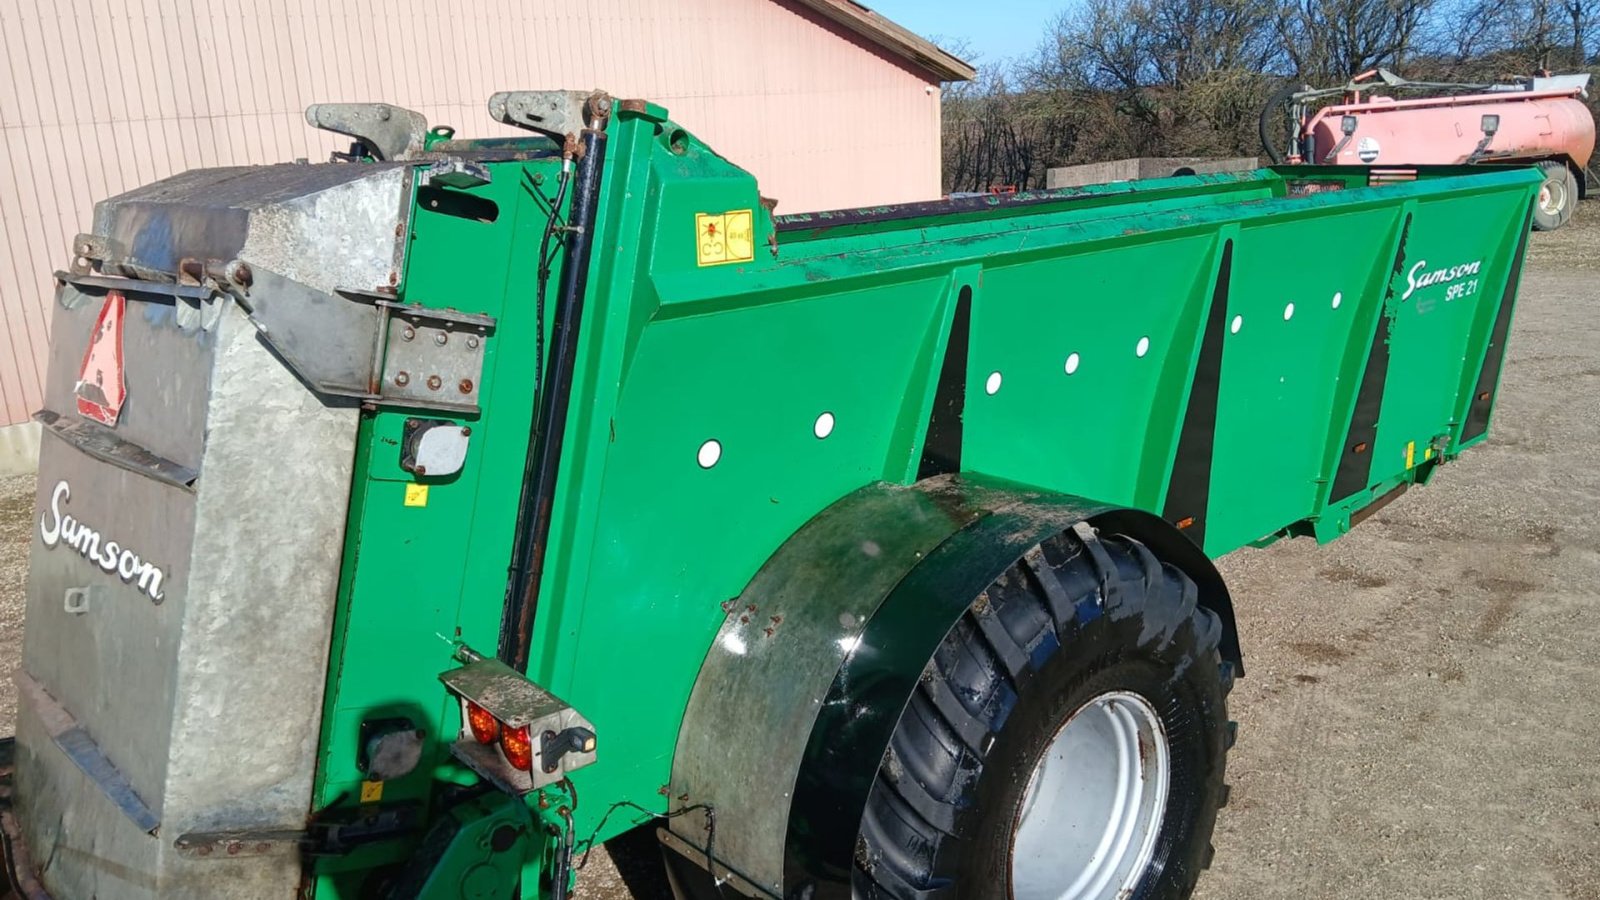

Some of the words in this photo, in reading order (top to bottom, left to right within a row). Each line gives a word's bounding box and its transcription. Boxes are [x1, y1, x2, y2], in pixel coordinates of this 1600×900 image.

[1401, 260, 1481, 301] Samson
[1445, 282, 1466, 302] SPE
[1466, 279, 1478, 297] 21
[40, 480, 164, 602] Samson
